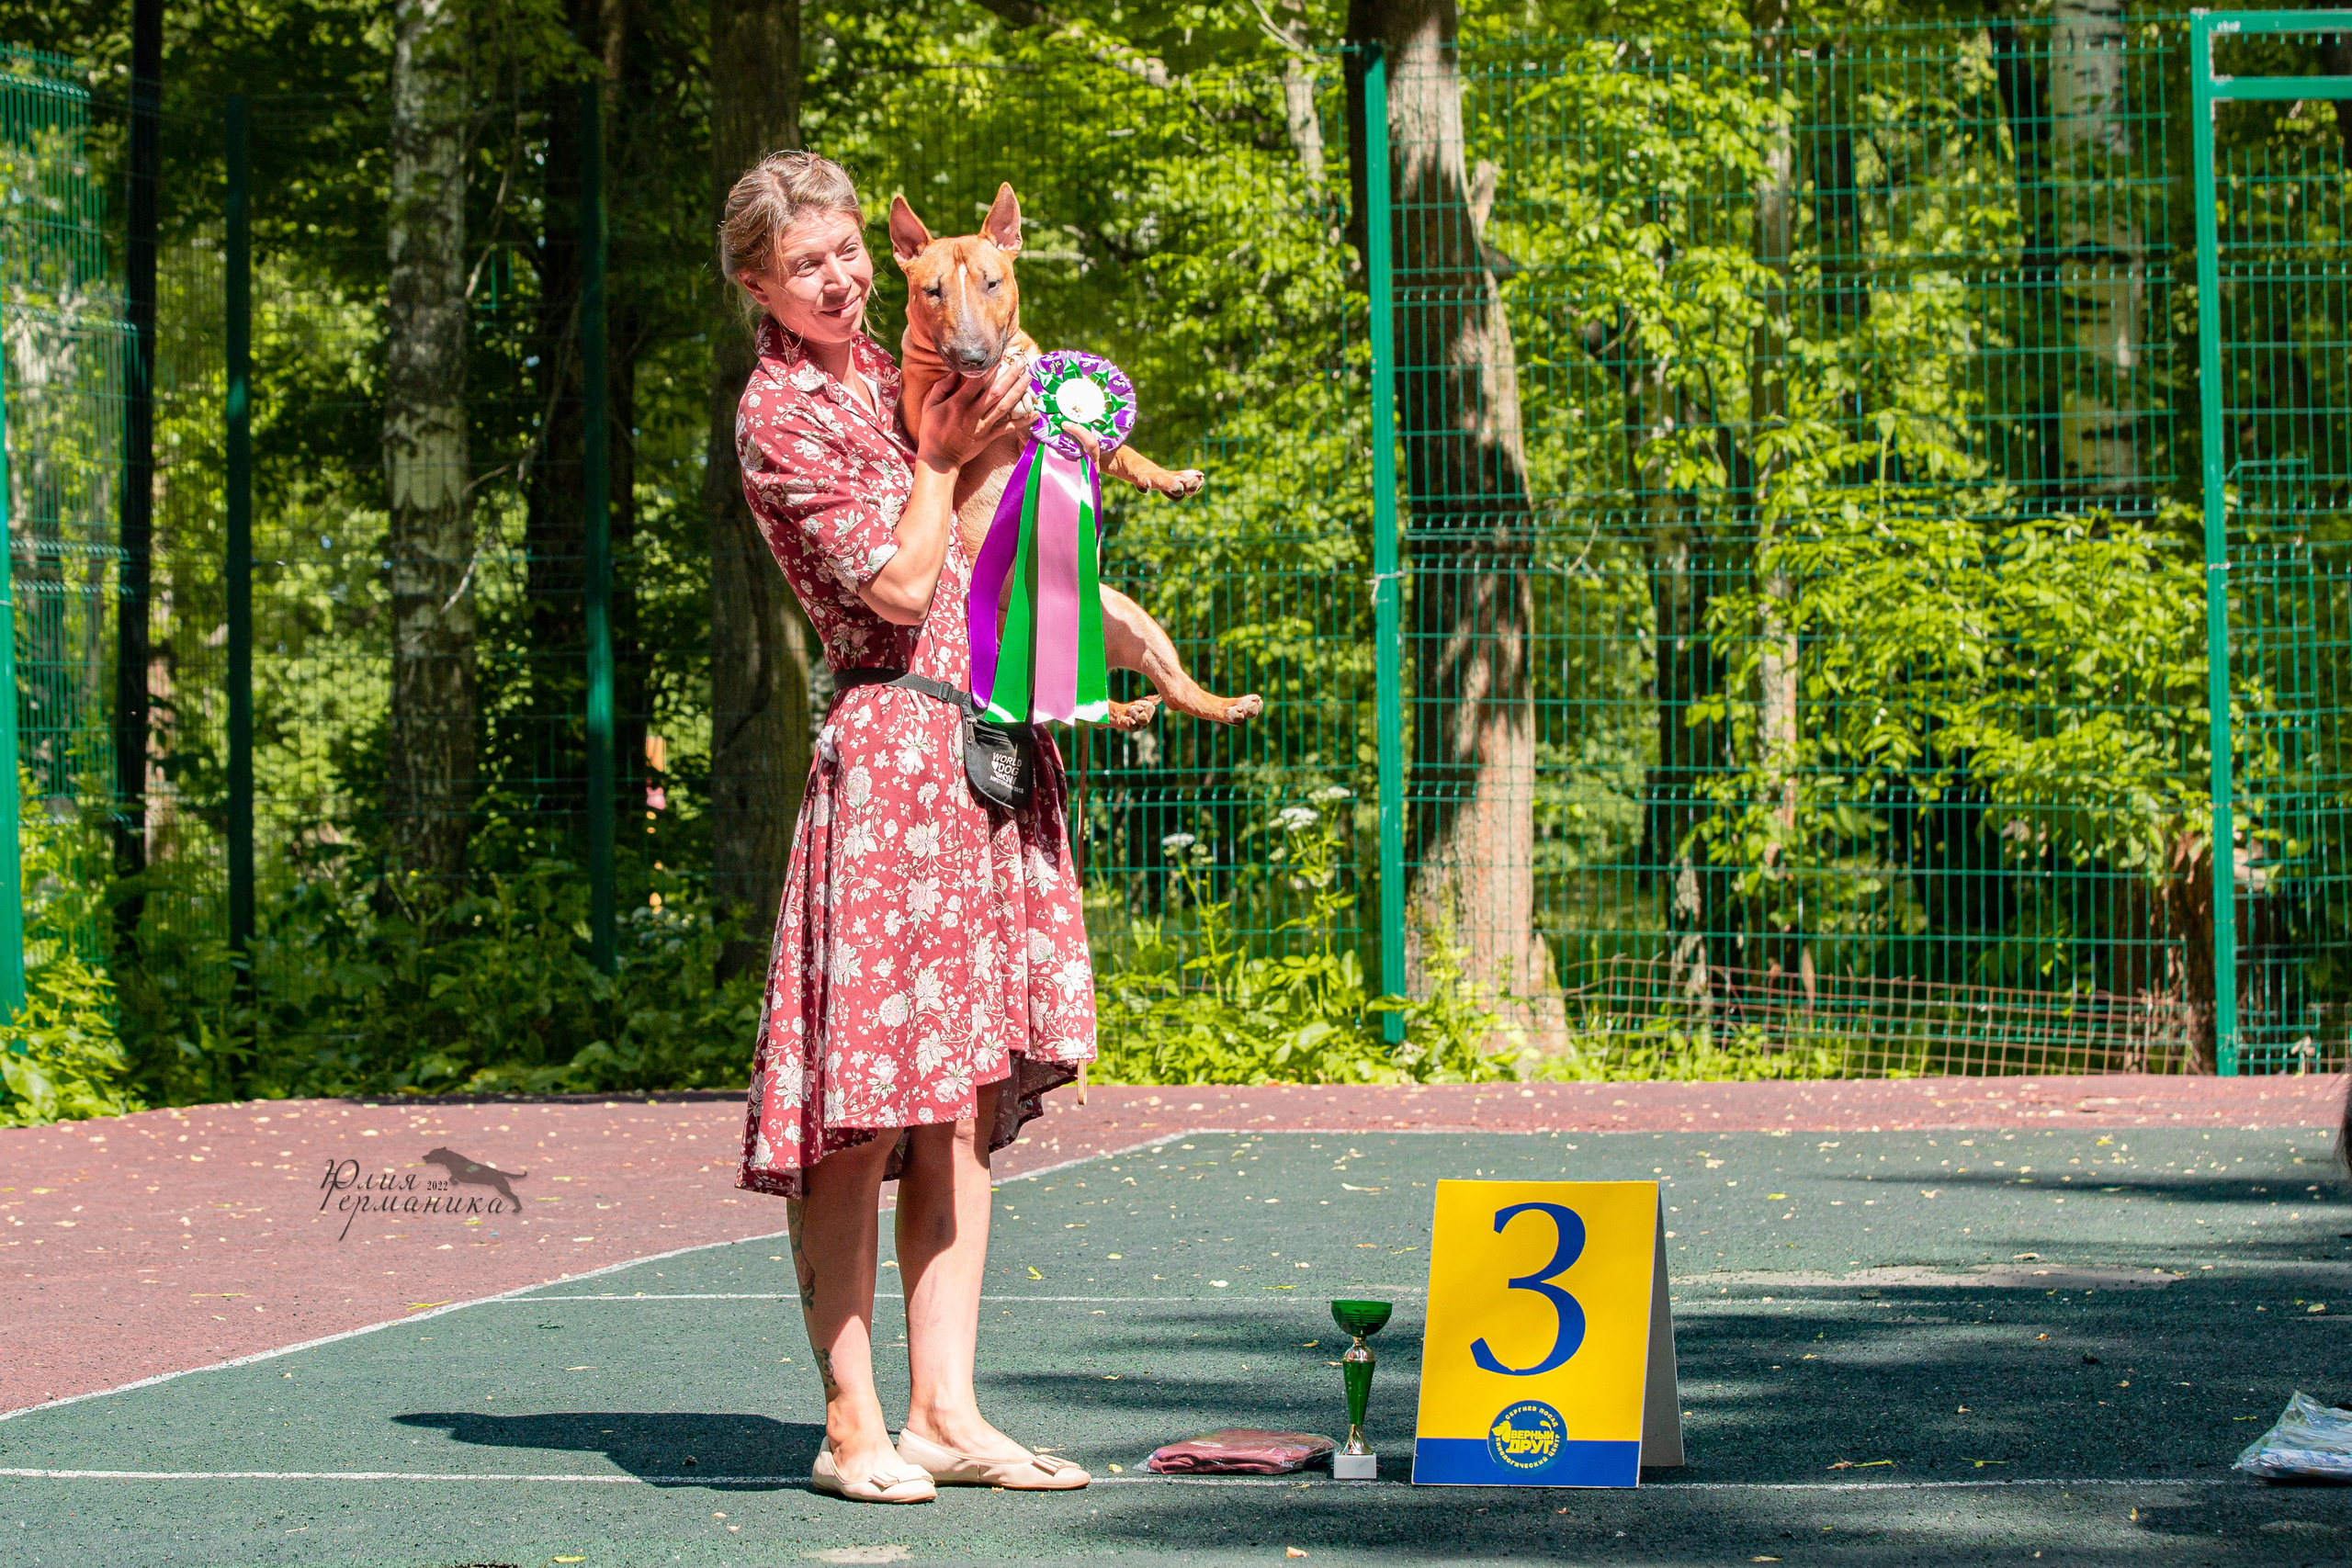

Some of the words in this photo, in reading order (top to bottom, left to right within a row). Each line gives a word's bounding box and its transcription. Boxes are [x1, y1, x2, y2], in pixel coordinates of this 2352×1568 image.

[992, 752, 1022, 767] WORLD
[999, 763, 1019, 775] DOG
[994, 771, 1017, 785] SHOW
[1470, 1201, 1586, 1376] 3
[1505, 1405, 1537, 1420] СЕРГИЕВ
[1539, 1407, 1559, 1427] ПОСАД
[1510, 1429, 1555, 1440] ВЕРНЫЙ
[1495, 1437, 1549, 1469] КИНОЛОГИЧЕСКИЙ
[1548, 1434, 1561, 1457] ЦЕНТР
[1506, 1439, 1554, 1454] ДРУГ
